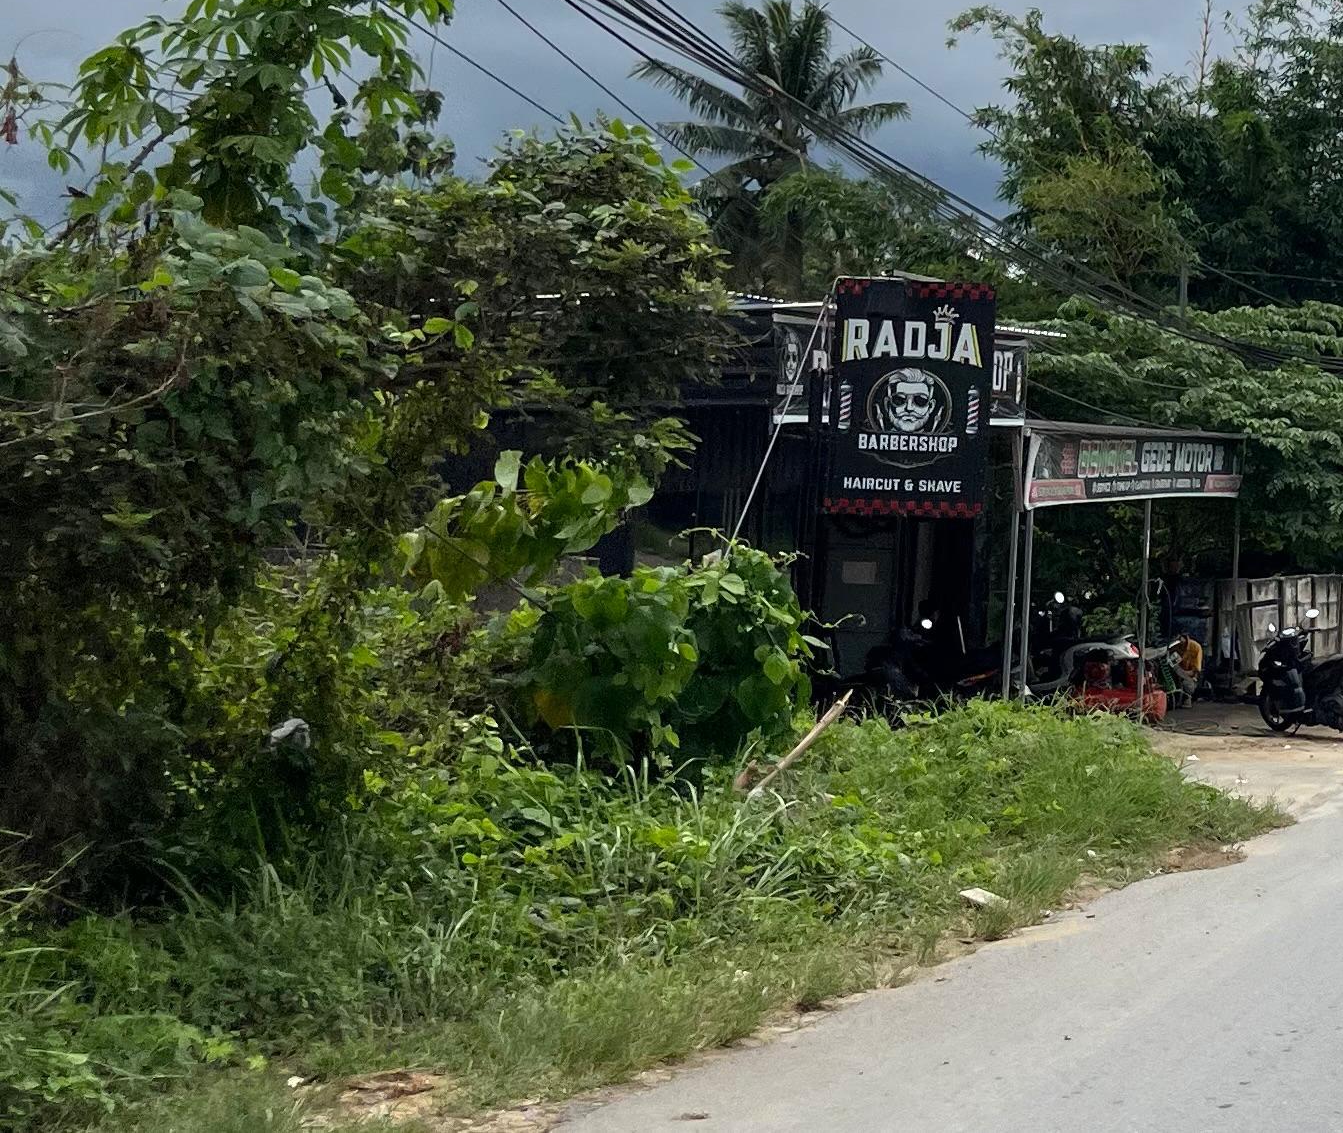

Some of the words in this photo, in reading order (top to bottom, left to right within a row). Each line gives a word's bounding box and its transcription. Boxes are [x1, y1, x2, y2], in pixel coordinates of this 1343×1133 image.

[842, 318, 983, 368] RADJA
[858, 433, 958, 453] BARBERSHOP
[1140, 441, 1173, 473] GEDE
[1174, 442, 1214, 473] MOTOR
[843, 476, 900, 491] HAIRCUT
[904, 478, 914, 491] &
[918, 478, 962, 493] SHAVE
